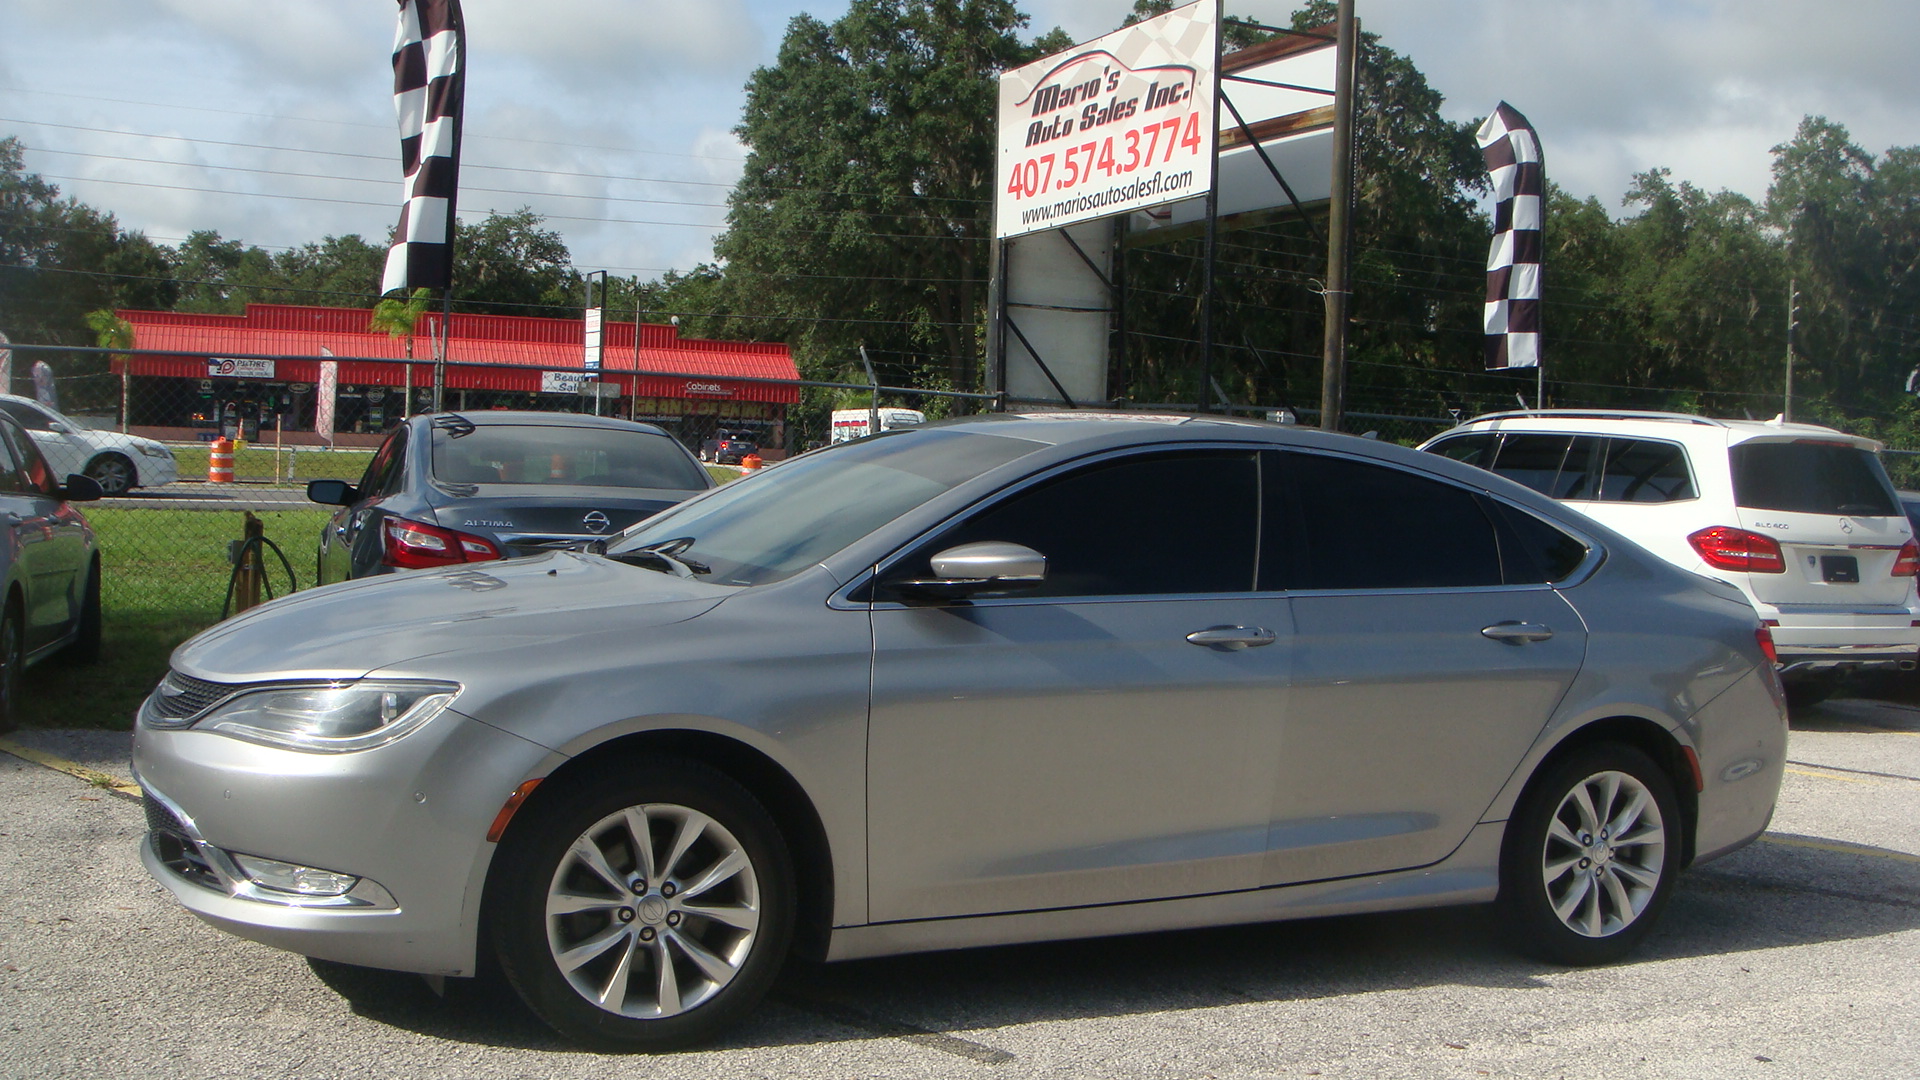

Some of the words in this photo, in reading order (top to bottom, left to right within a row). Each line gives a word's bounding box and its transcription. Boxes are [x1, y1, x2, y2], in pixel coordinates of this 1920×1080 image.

[1025, 116, 1074, 148] Auto
[1079, 97, 1139, 132] Sales
[1144, 80, 1190, 112] Inc.
[1031, 65, 1121, 118] Mario's
[1007, 111, 1201, 201] 407.574.3774
[1021, 170, 1193, 225] www.mariosautosalesfl.com
[636, 400, 693, 415] GRAND
[686, 381, 721, 391] Cabinets
[464, 520, 514, 528] ALTIMA
